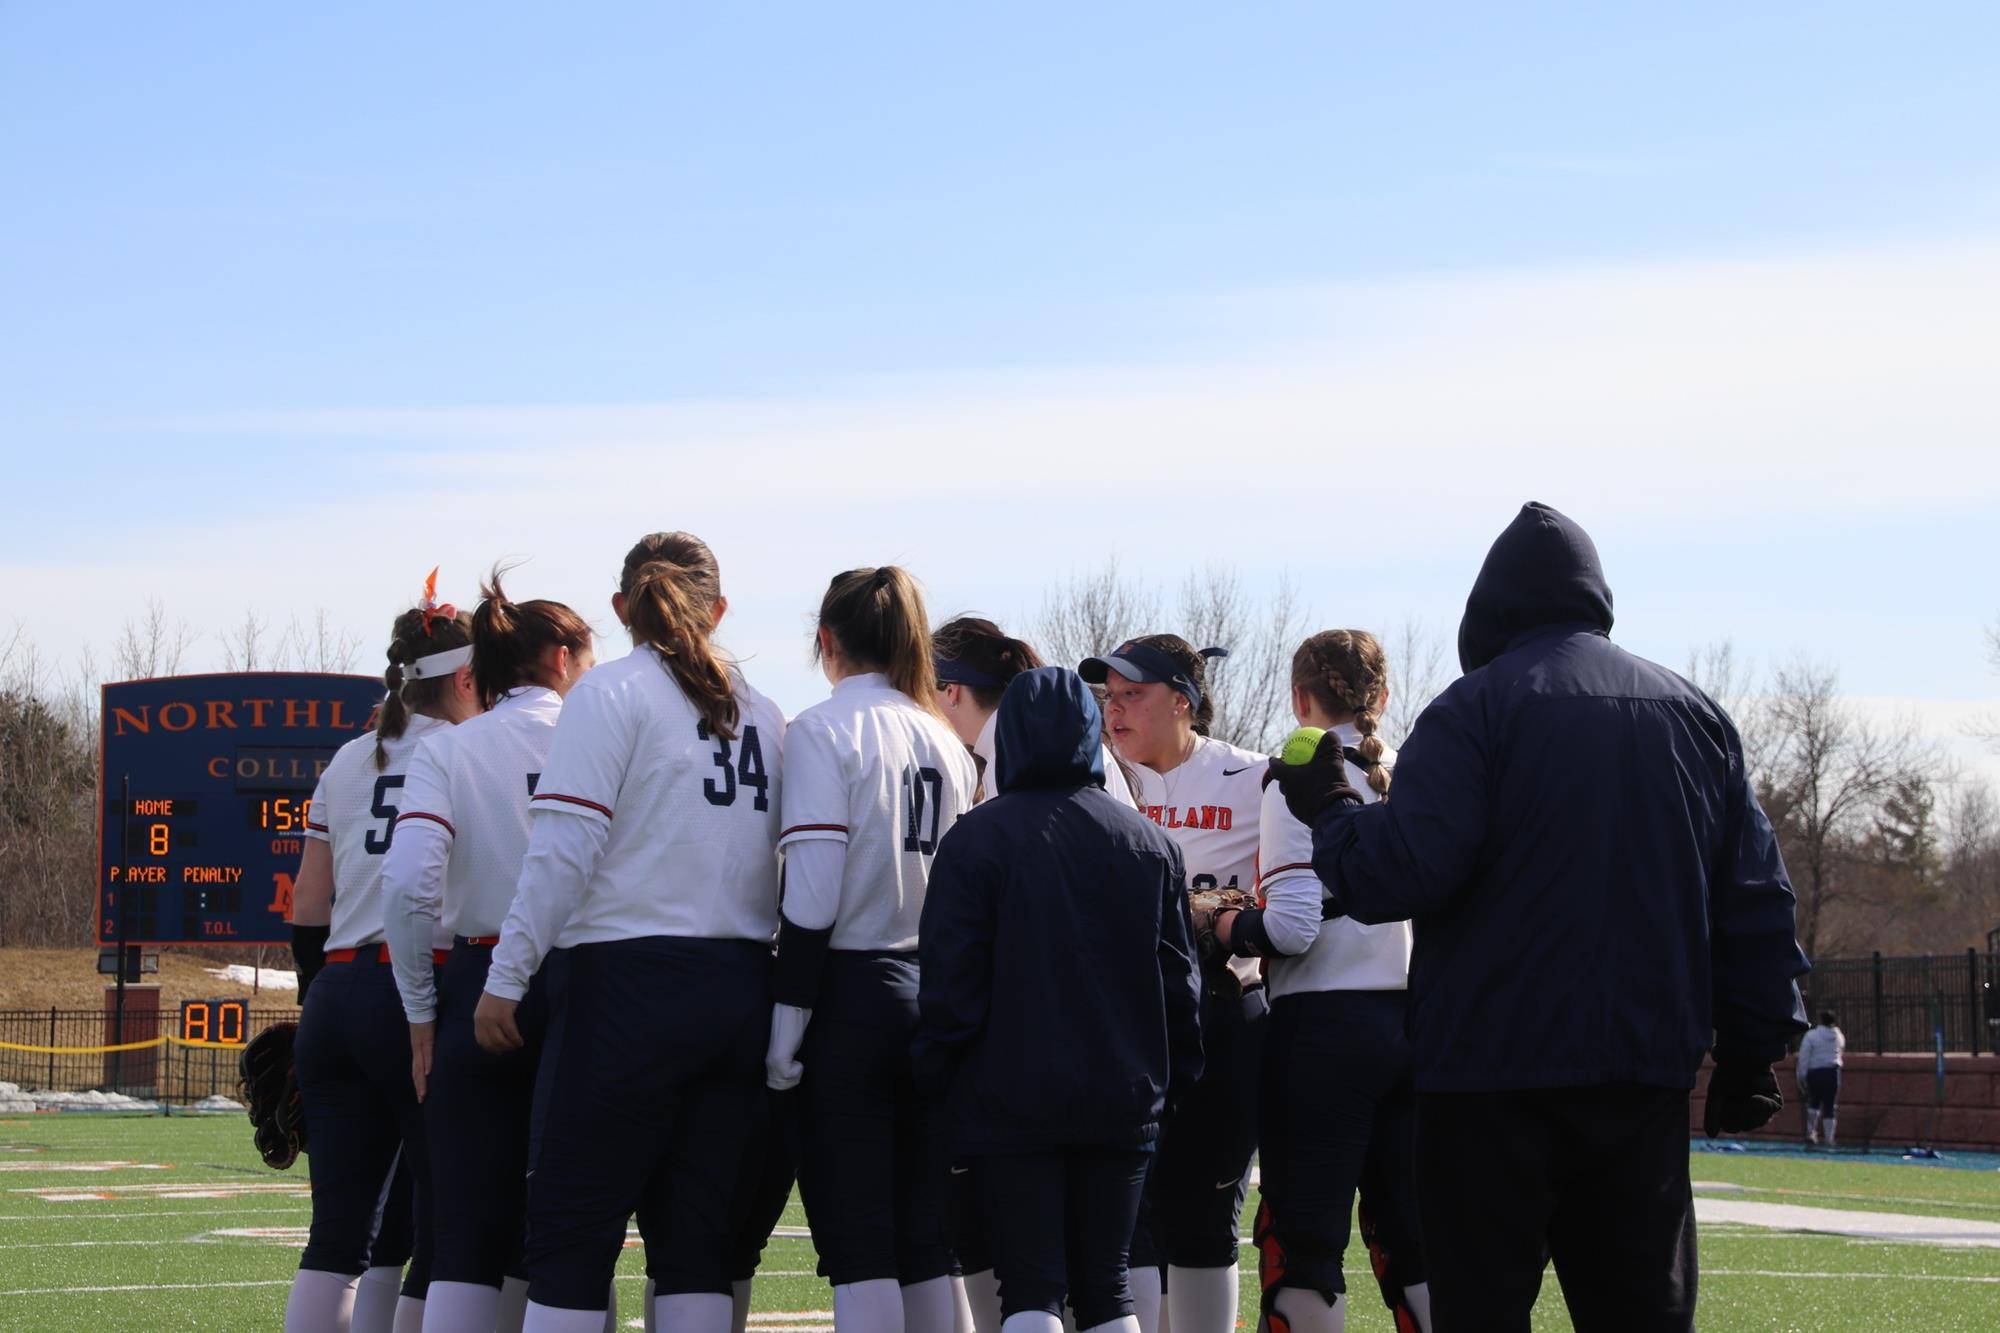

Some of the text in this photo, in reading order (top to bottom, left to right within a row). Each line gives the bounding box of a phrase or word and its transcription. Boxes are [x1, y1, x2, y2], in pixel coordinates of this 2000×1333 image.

[696, 718, 768, 812] 34
[135, 799, 173, 816] HOME
[364, 774, 406, 855] 5
[902, 764, 943, 856] 10
[1139, 805, 1232, 831] HLAND
[150, 824, 169, 855] 8
[110, 866, 243, 883] PAYER PENALTY
[106, 892, 114, 906] 1
[105, 919, 114, 935] 2
